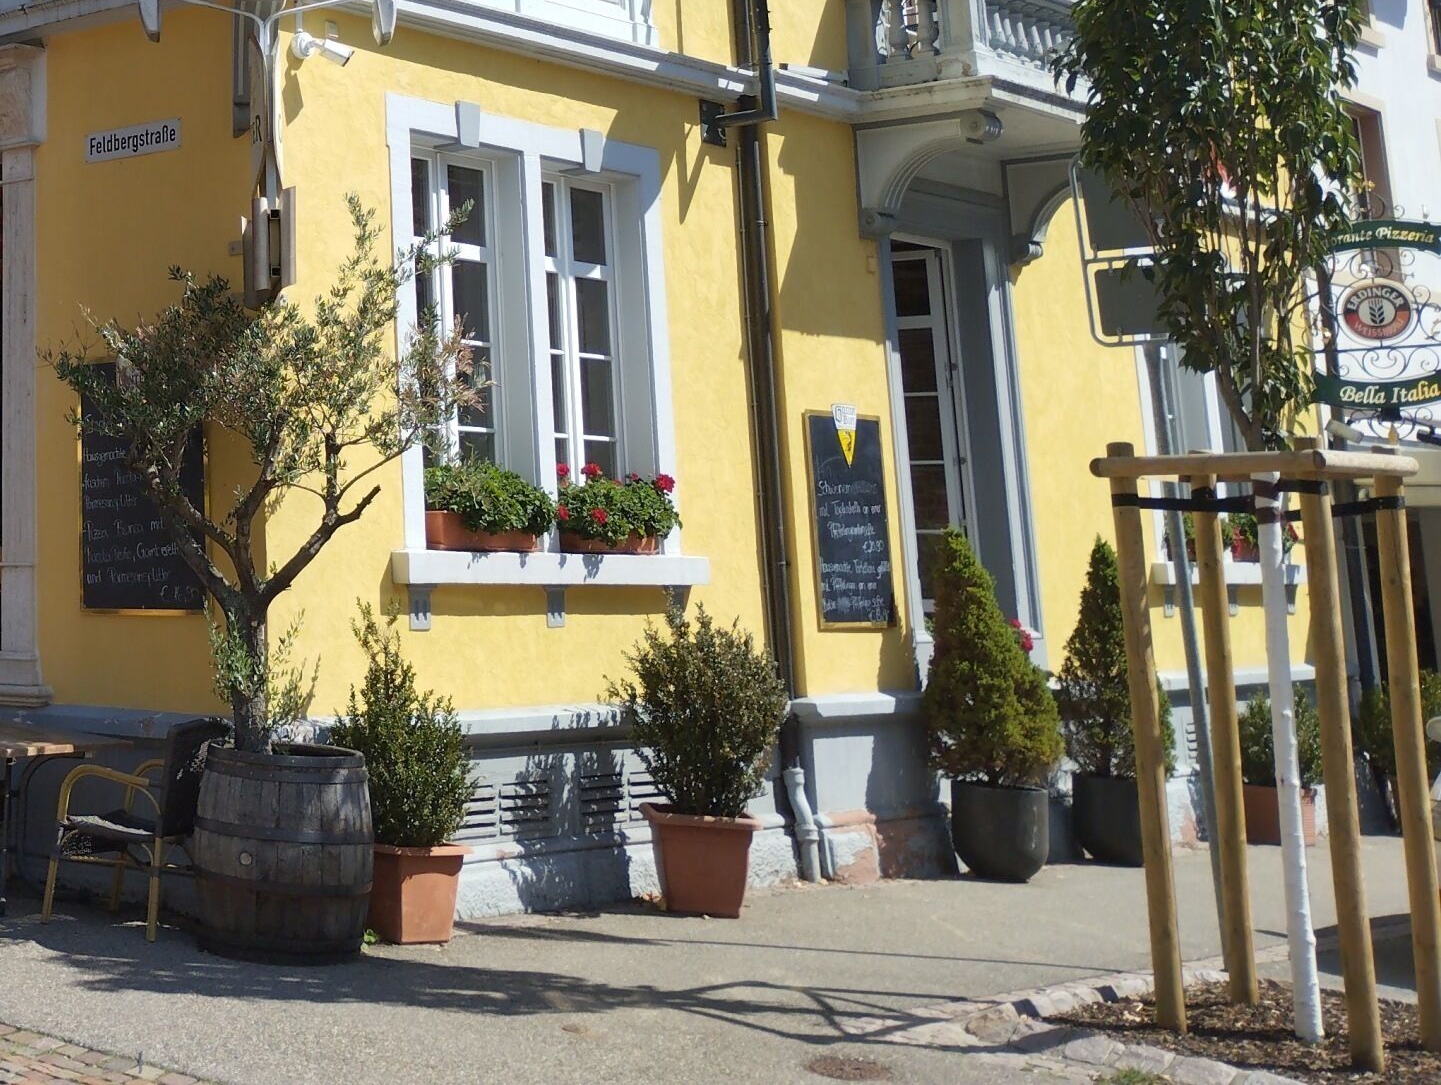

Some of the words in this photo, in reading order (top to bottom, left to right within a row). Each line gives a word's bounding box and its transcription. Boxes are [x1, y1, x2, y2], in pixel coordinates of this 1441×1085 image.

[89, 124, 176, 156] Feldbergstraße
[1375, 226, 1434, 244] Pizzeria
[1346, 286, 1405, 311] ERDINGER
[1340, 385, 1386, 405] Bella
[1391, 380, 1441, 404] Italia
